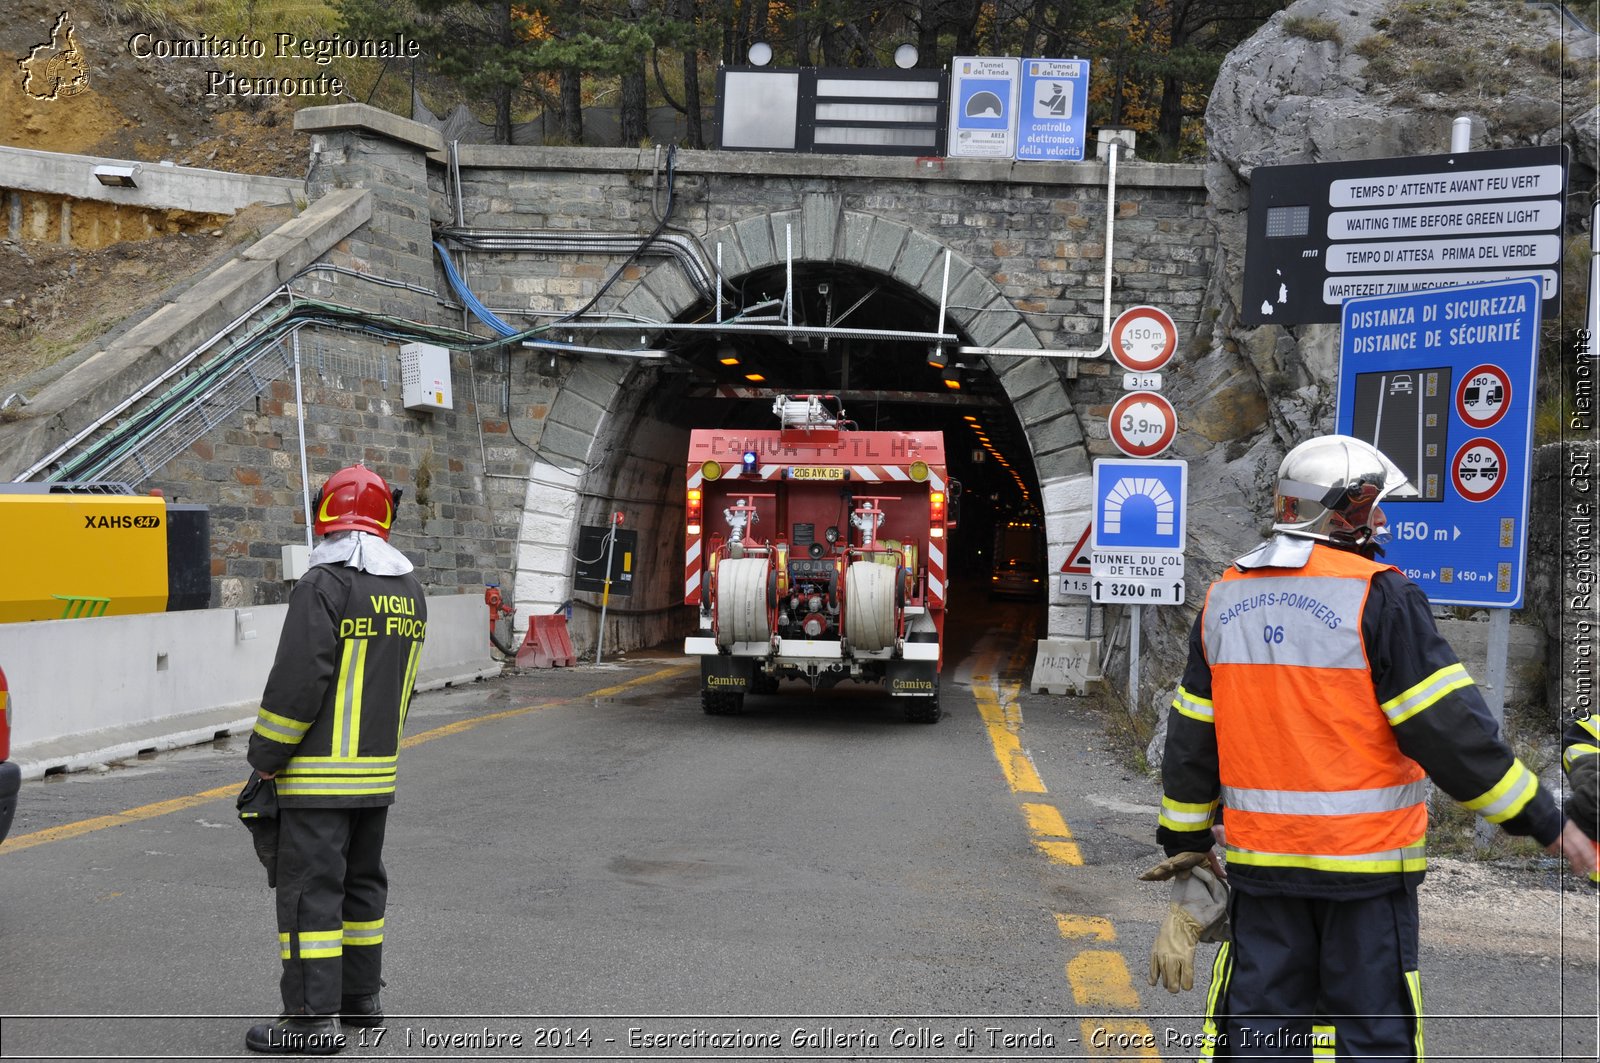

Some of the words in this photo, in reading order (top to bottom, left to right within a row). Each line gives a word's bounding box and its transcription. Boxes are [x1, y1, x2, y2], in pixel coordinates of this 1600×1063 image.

[1032, 122, 1071, 132] controllo
[1027, 134, 1075, 144] elettronico
[1020, 145, 1042, 155] della
[1046, 145, 1080, 156] velocità
[1350, 186, 1385, 199] TEMPS
[1400, 182, 1446, 196] ATTENTE
[1450, 179, 1484, 194] AVANT
[1487, 177, 1508, 190] FEU
[1511, 175, 1540, 189] VERT
[1346, 218, 1389, 232] WAITING
[1392, 216, 1418, 229] TIME
[1420, 213, 1463, 227] BEFORE
[1466, 211, 1503, 225] GREEN
[1507, 210, 1540, 223] LIGHT
[1302, 249, 1318, 258] mn
[1346, 251, 1380, 264] TEMPO
[1384, 250, 1394, 262] DI
[1395, 248, 1434, 262] ATTESA
[1442, 247, 1476, 260] PRIMA
[1478, 246, 1500, 258] DEL
[1502, 244, 1537, 258] VERDE
[1329, 284, 1384, 297] WARTEZEIT
[1352, 307, 1414, 329] DISTANZA
[1422, 305, 1437, 322] DI
[1445, 294, 1526, 320] SICUREZZA
[1128, 329, 1150, 340] 150
[1153, 332, 1162, 340] m
[1353, 332, 1416, 354] DISTANCE
[1425, 330, 1442, 348] DE
[1450, 318, 1521, 346] SÉCURITÉ
[1472, 377, 1488, 386] 150
[1467, 454, 1482, 463] 50
[794, 468, 810, 478] 206
[812, 469, 826, 478] AYK
[829, 469, 840, 478] 06
[84, 516, 132, 529] XAHS
[136, 517, 158, 528] 347
[1396, 522, 1428, 540] 150
[1434, 528, 1448, 540] m
[1094, 554, 1135, 565] TUNNEL
[1141, 556, 1156, 565] DU
[1162, 556, 1182, 566] COL
[1110, 566, 1124, 575] DE
[1130, 566, 1164, 576] TENDE
[1408, 570, 1421, 580] 50
[1422, 572, 1430, 580] m
[1464, 572, 1477, 582] 50
[1479, 574, 1487, 582] m
[1111, 584, 1145, 597] 3200
[1150, 588, 1162, 598] m
[370, 595, 415, 616] VIGILI
[1219, 592, 1342, 630] SAPEURS-POMPIERS
[340, 618, 378, 638] DEL
[1263, 625, 1284, 644] 06
[708, 674, 746, 686] Camiva
[892, 678, 932, 689] Camiva
